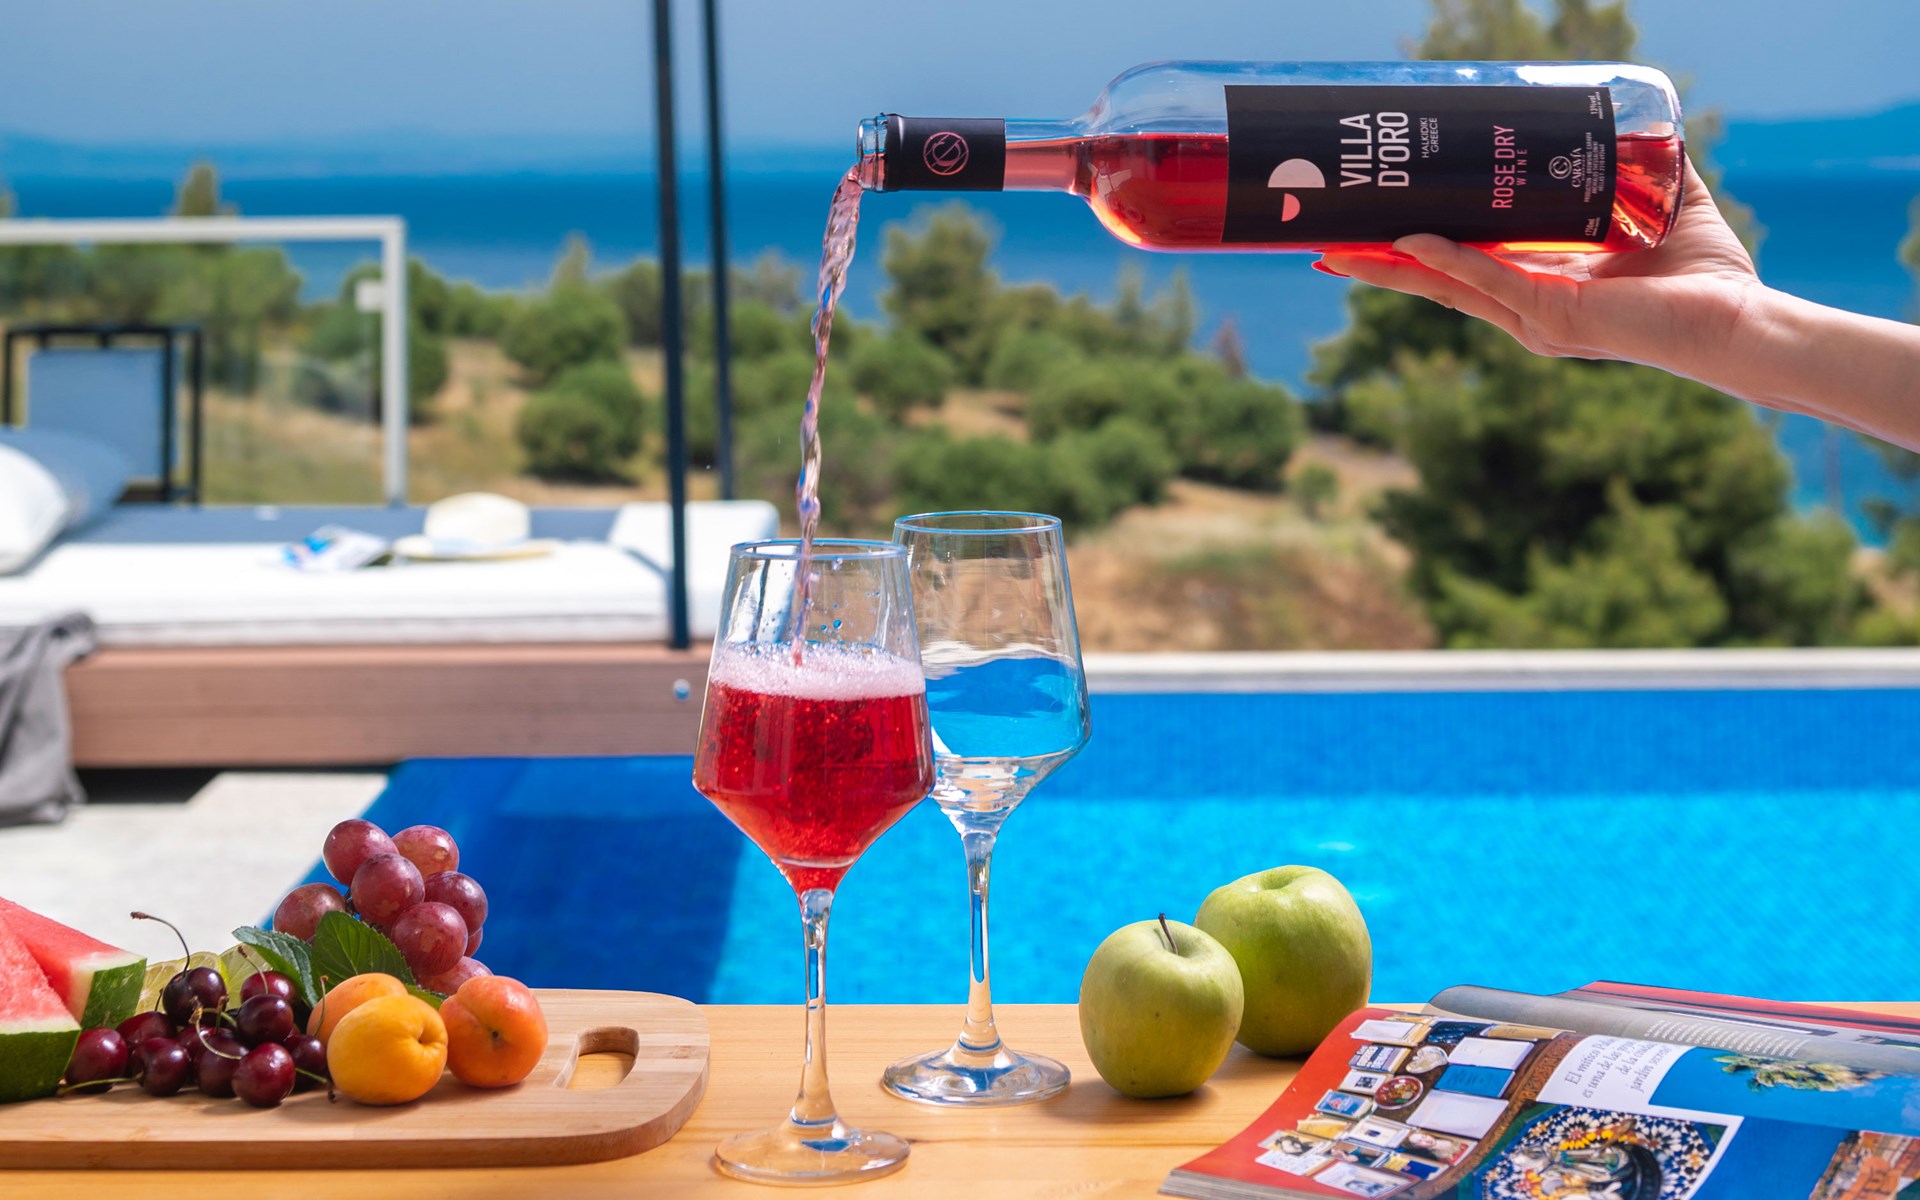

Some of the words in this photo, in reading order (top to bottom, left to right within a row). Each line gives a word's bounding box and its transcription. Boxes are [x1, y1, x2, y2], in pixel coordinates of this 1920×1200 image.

[1339, 113, 1372, 188] VILLA
[1376, 111, 1410, 187] D'ORO
[1420, 117, 1430, 158] HALKIDIKI
[1429, 117, 1440, 153] GREECE
[1493, 125, 1515, 159] DRY
[1492, 164, 1515, 208] ROSE
[1516, 149, 1528, 186] WINE
